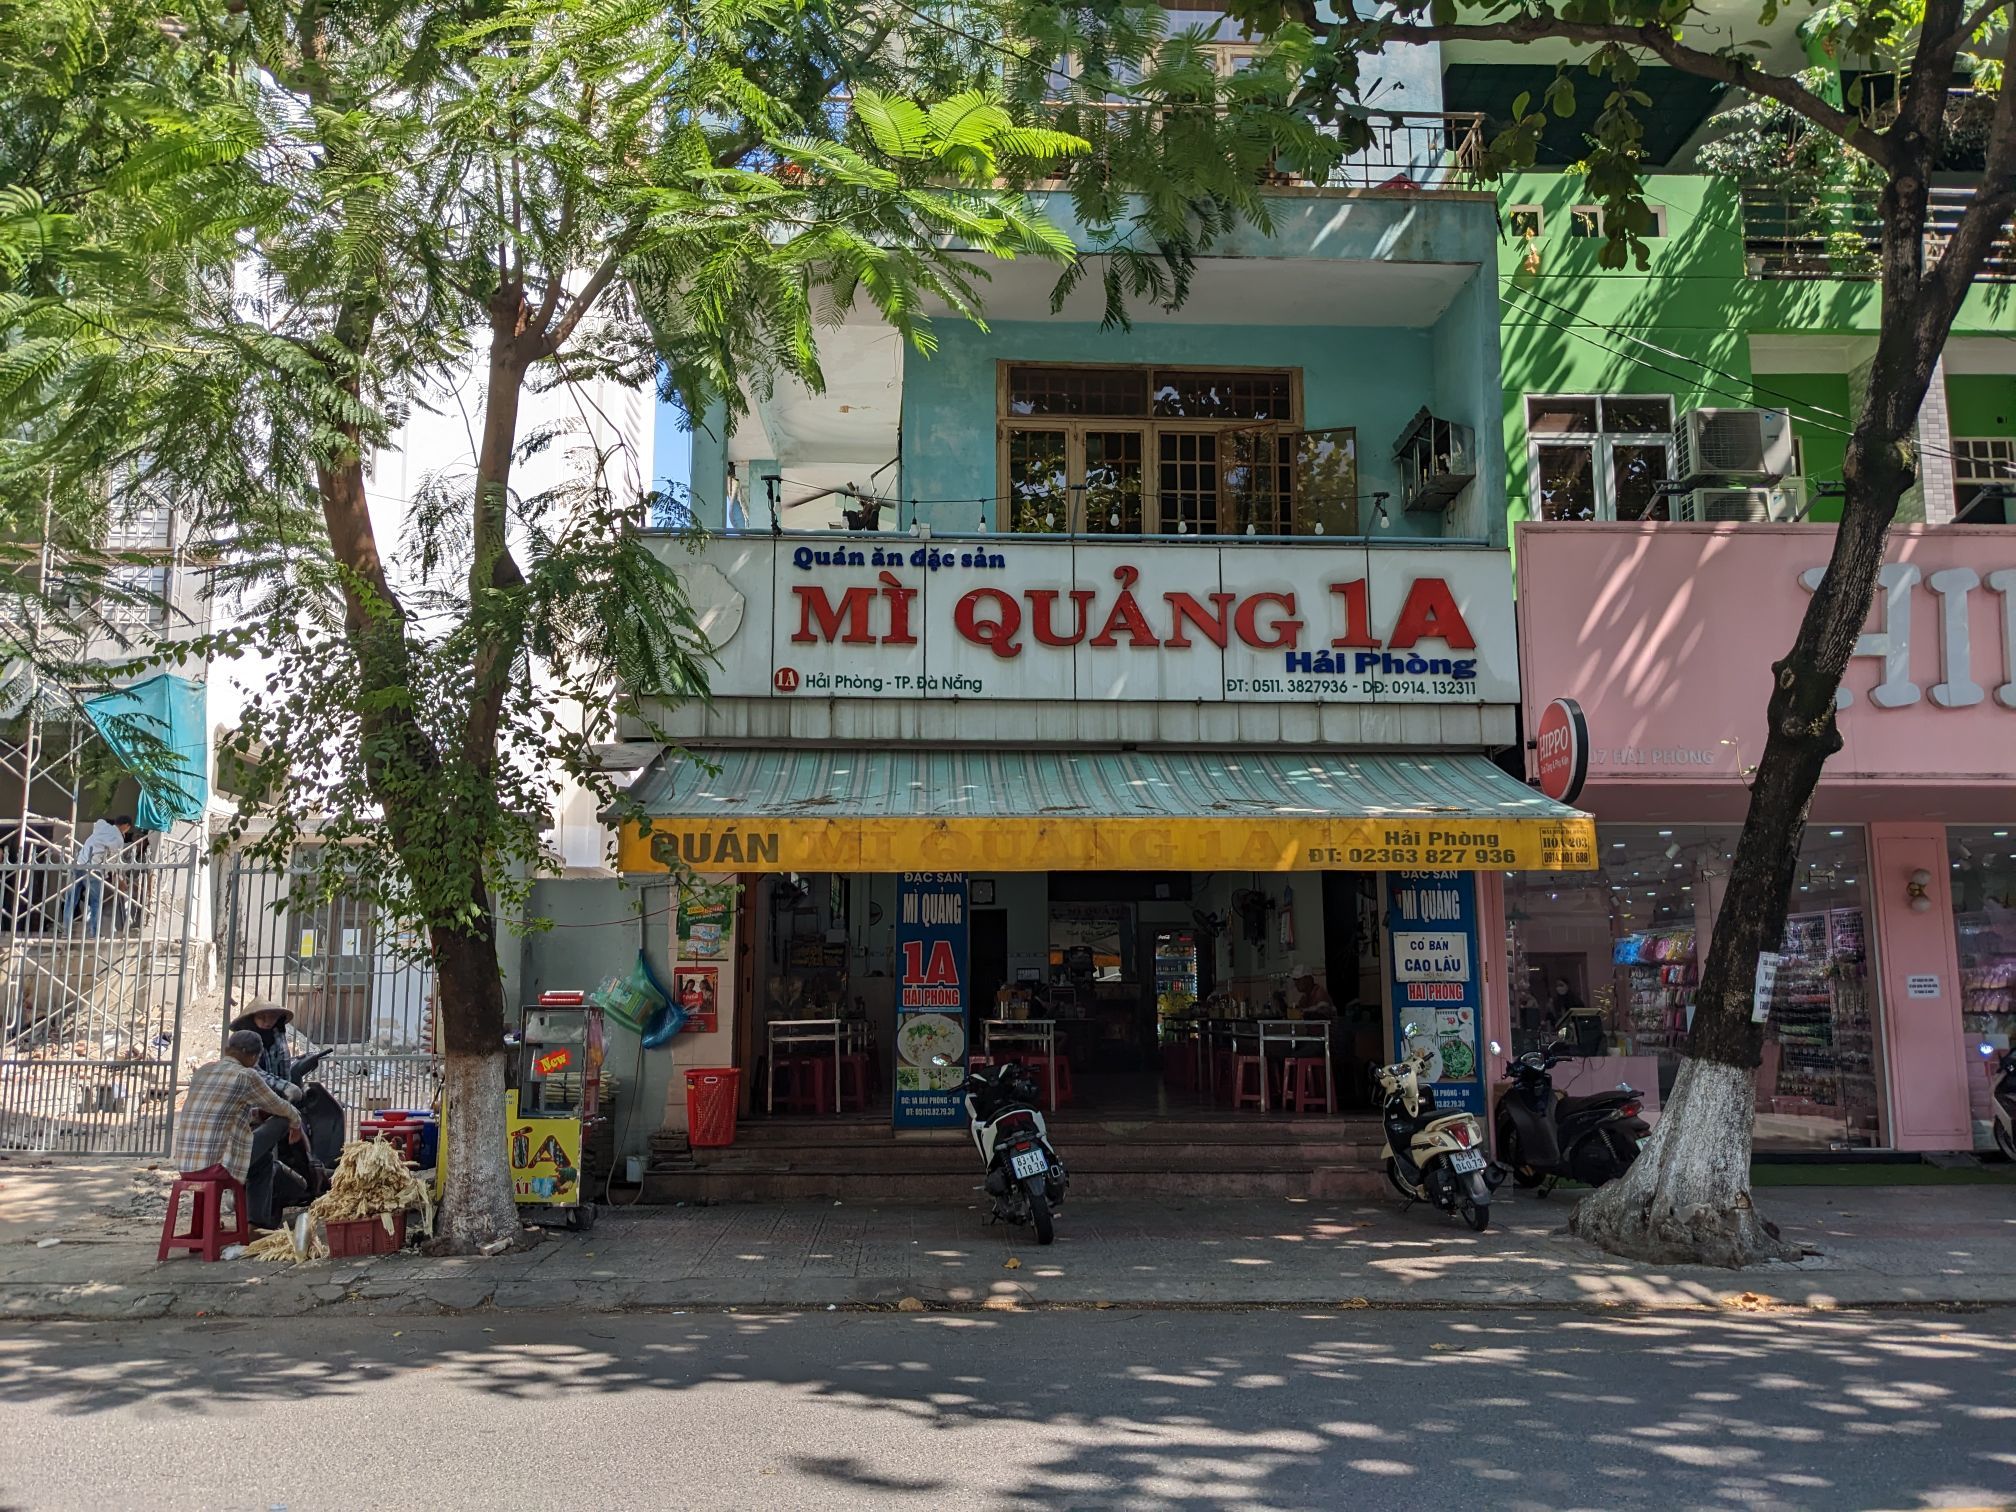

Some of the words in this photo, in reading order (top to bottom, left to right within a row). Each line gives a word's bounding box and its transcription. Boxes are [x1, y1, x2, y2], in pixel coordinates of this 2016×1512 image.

[793, 546, 865, 570] Quán
[871, 547, 904, 567] ăn
[910, 548, 955, 572] đặc
[961, 546, 1005, 568] sản
[790, 569, 918, 645] MÌ
[954, 565, 1303, 658] QUẢNG
[1328, 577, 1476, 649] 1A
[1285, 649, 1346, 675] Hải
[1354, 652, 1477, 681] Phòng
[777, 671, 796, 689] 1A
[806, 672, 831, 689] Hải
[835, 674, 883, 691] Phòng
[895, 675, 914, 690] TP.
[917, 675, 938, 690] Đà
[942, 674, 983, 693] Nẵng
[1227, 680, 1249, 693] ĐT:
[1540, 725, 1568, 761] HIPPO
[1651, 744, 1714, 765] PHÒNG
[650, 827, 779, 864] QUÁN
[1385, 830, 1421, 847] Hải
[1428, 829, 1500, 848] Phòng
[1308, 848, 1342, 864] ĐT:
[1350, 848, 1419, 864] 02363
[1425, 848, 1467, 864] 827
[1475, 848, 1516, 864] 936
[903, 889, 919, 924] MÌ
[921, 886, 962, 928] QUẢNG
[1402, 884, 1418, 920] MÌ
[1420, 882, 1461, 923] QUẢNG
[1410, 936, 1425, 951] CÓ
[1429, 936, 1449, 951] BÁN
[902, 940, 960, 986] 1A
[1404, 958, 1431, 973] CAO
[1434, 954, 1461, 973] LẦU
[922, 985, 960, 1007] PHÒNG
[540, 1053, 567, 1072] New
[511, 1126, 572, 1169] ÍA
